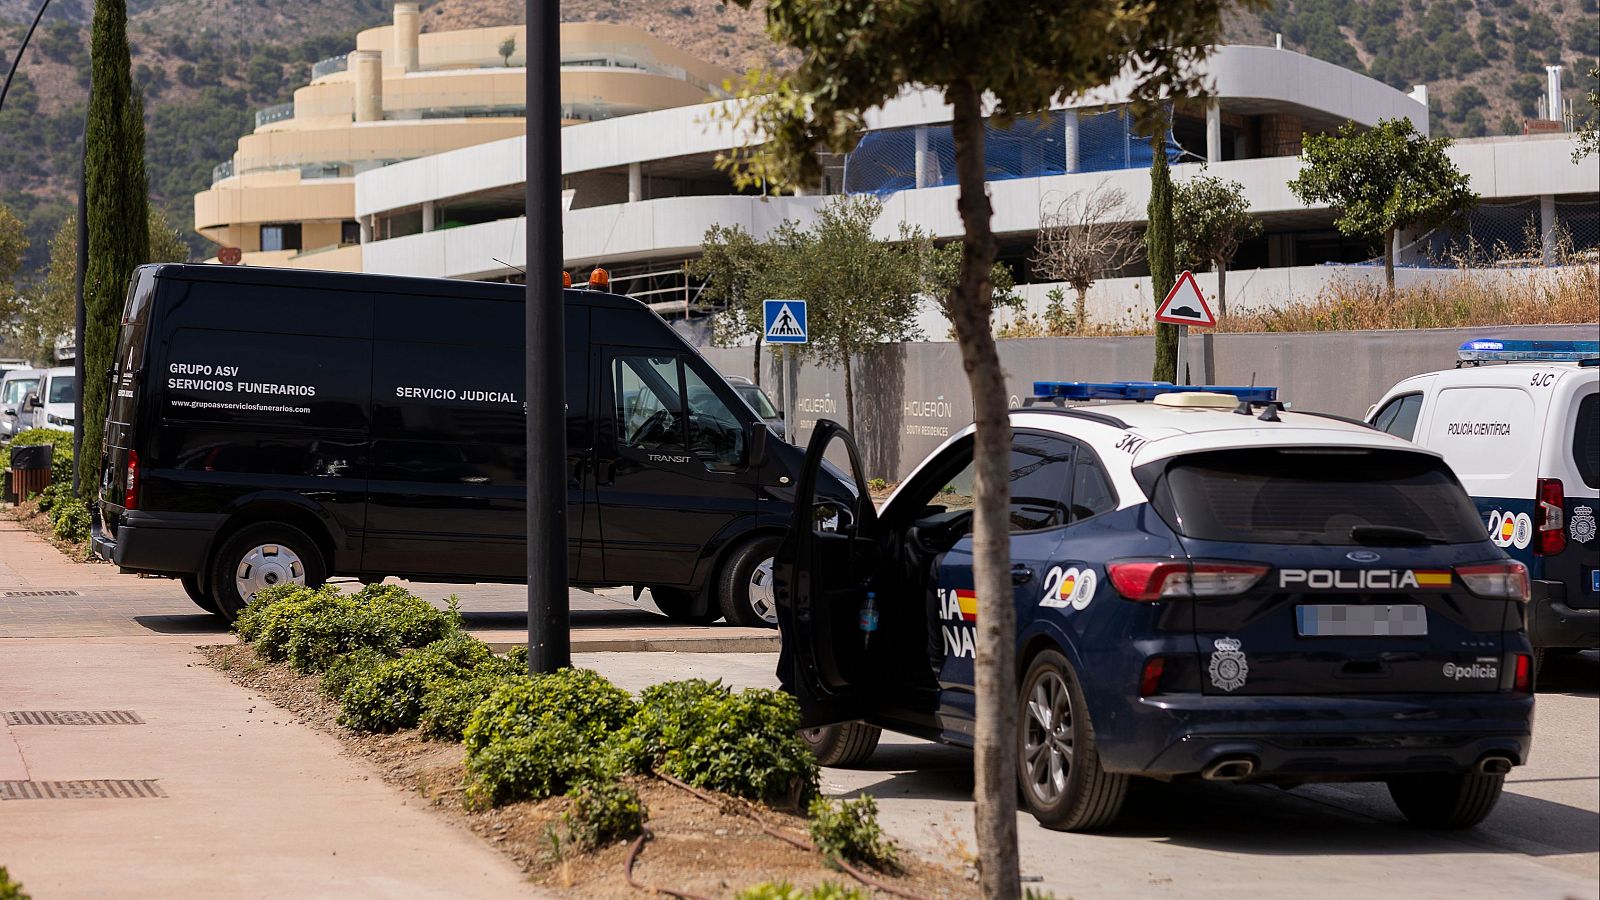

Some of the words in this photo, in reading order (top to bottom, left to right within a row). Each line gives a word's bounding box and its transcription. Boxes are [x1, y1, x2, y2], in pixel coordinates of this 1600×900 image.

[169, 363, 212, 375] GRUPO
[214, 366, 239, 376] ASV
[167, 378, 234, 392] SERVICIOS
[237, 382, 316, 396] FUNERARIOS
[1530, 373, 1554, 387] 9JC
[396, 387, 456, 400] SERVICIO
[460, 390, 518, 403] JUDICIAL
[171, 400, 311, 414] www.grupoasvserviciosfunerarios.com
[1447, 420, 1473, 435] POLICÍA
[1474, 420, 1511, 435] CIENTÍFICA
[647, 454, 691, 463] TRANSIT
[1487, 510, 1532, 549] 200
[1039, 565, 1097, 611] 200
[1442, 662, 1497, 680] @policia
